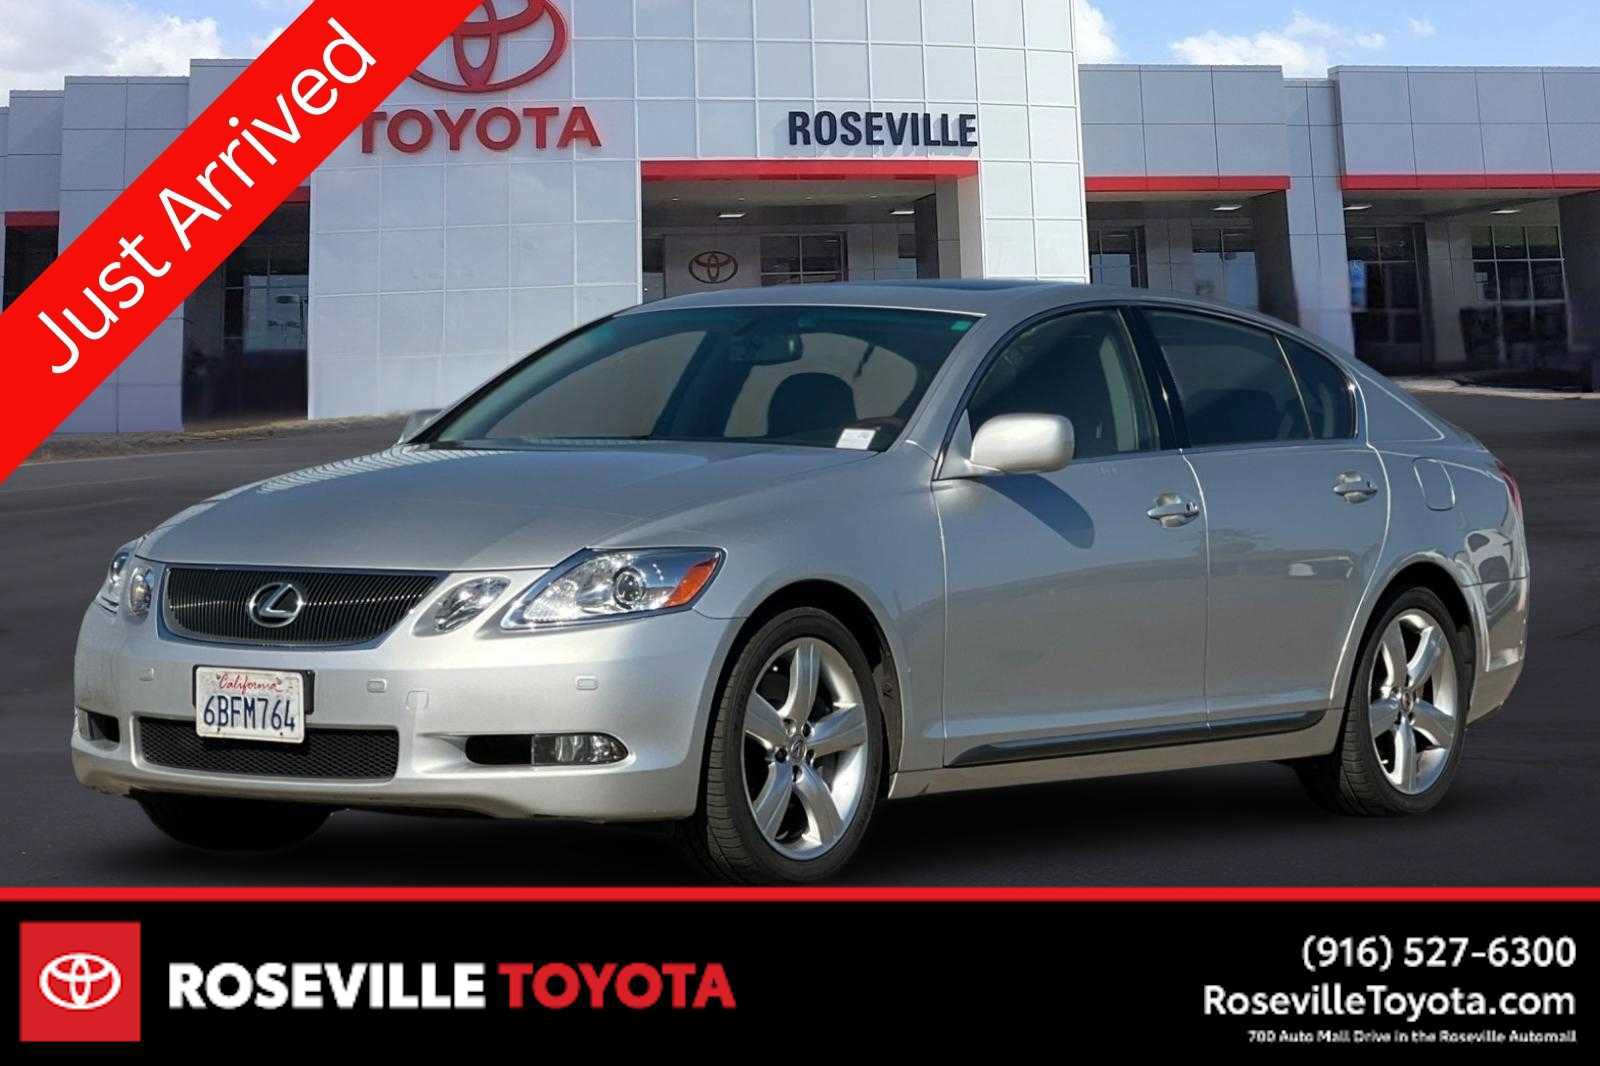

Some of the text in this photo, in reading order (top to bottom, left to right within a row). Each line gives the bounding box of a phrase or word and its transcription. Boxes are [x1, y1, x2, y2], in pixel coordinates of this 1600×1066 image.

[361, 106, 602, 154] TOYOTA
[787, 110, 979, 147] ROSEVILLE
[217, 671, 284, 695] California
[203, 694, 295, 732] 6BFM764
